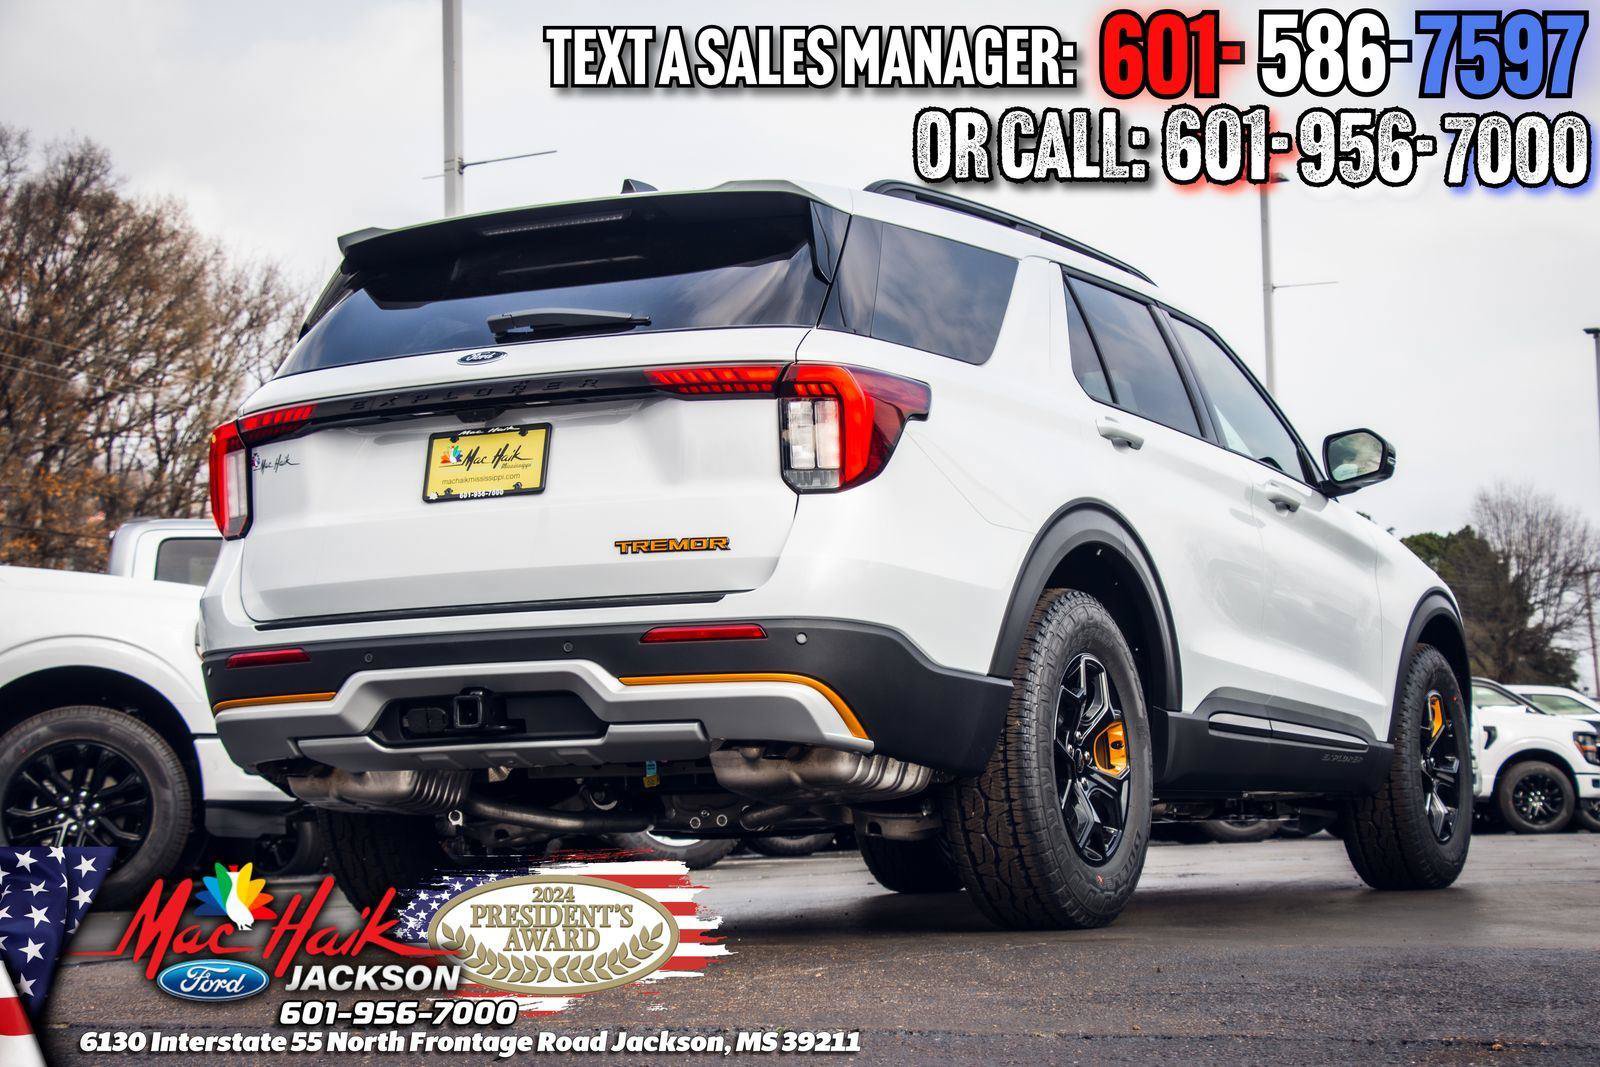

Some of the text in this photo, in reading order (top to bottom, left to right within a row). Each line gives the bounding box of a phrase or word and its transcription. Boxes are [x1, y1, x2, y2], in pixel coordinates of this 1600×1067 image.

[350, 378, 599, 410] EXPLORER
[461, 443, 533, 471] Mac Haik
[441, 473, 520, 485] machaikmississippi.com
[459, 490, 504, 499] 601-956-7000
[614, 536, 731, 555] TREMOR
